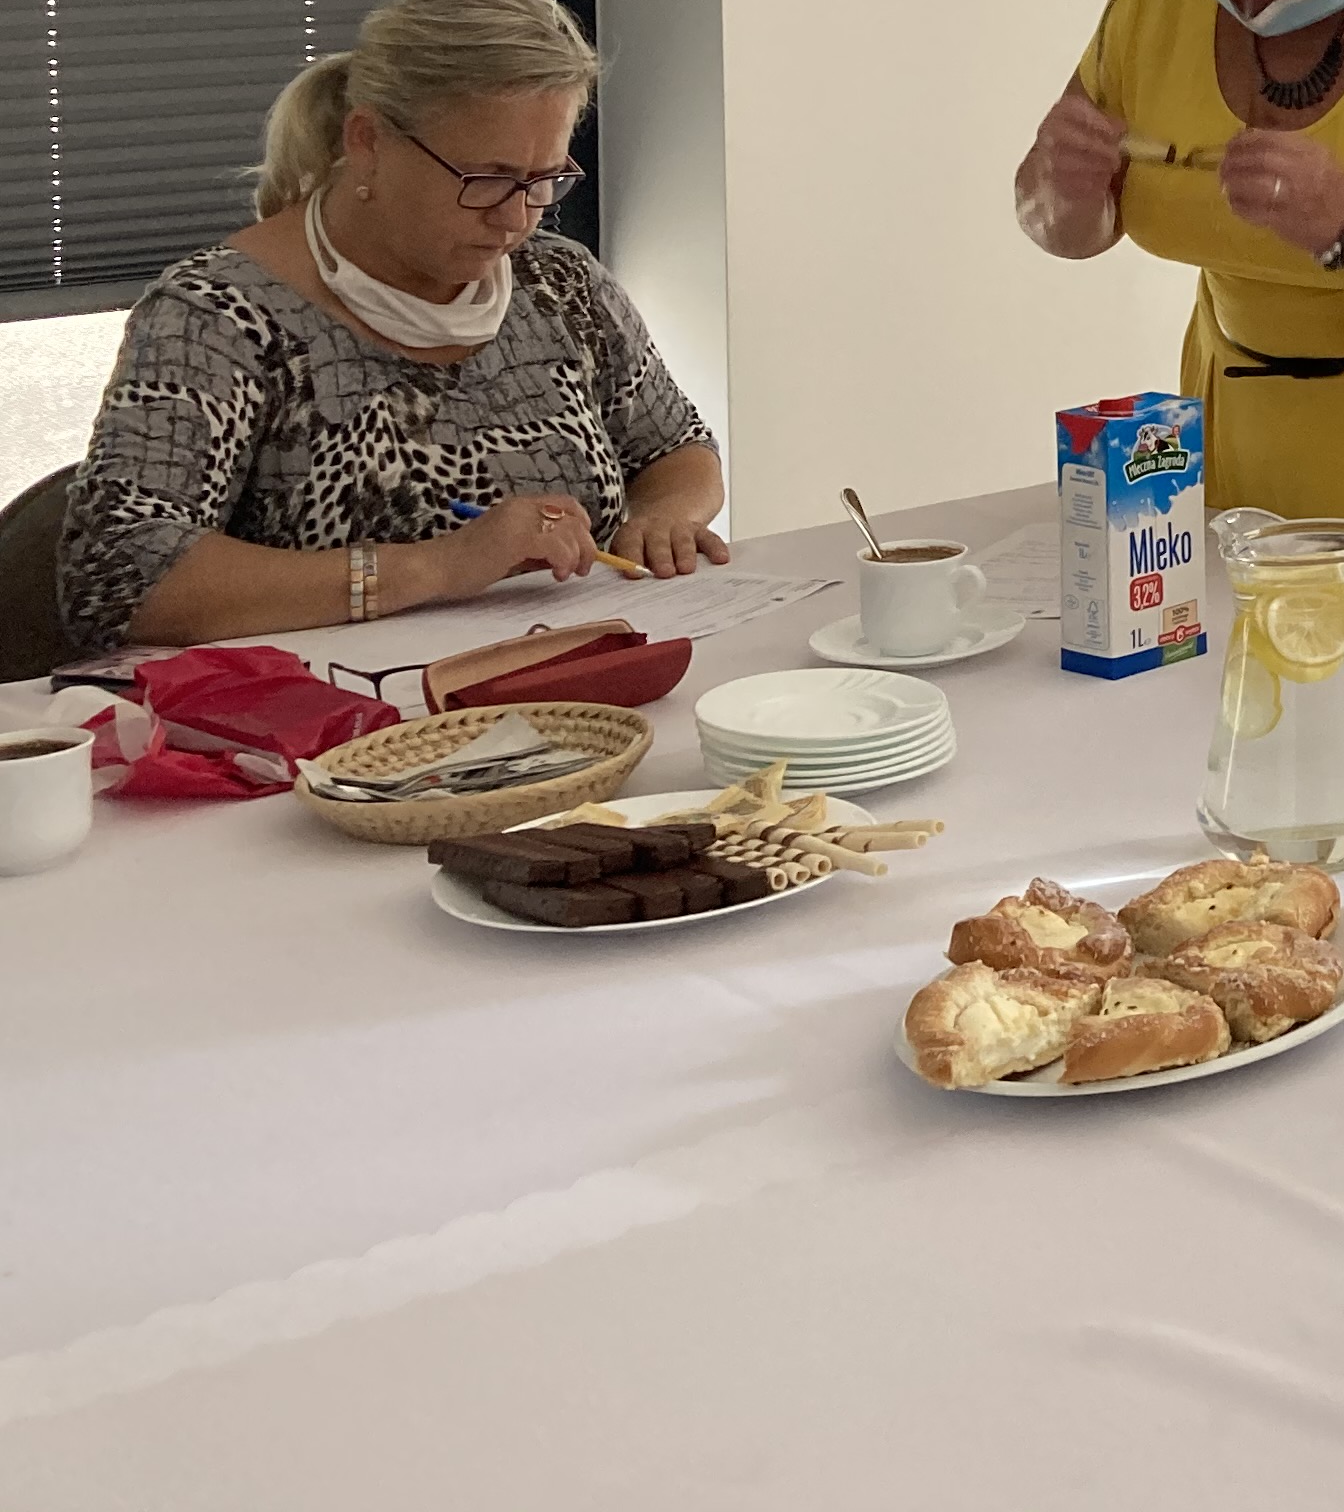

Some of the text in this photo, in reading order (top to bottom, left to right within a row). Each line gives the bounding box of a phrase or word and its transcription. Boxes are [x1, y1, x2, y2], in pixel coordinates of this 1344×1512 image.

[1128, 454, 1185, 479] Mleczna Zagroda
[1129, 521, 1191, 577] Mleko
[1133, 581, 1160, 610] 3,2%
